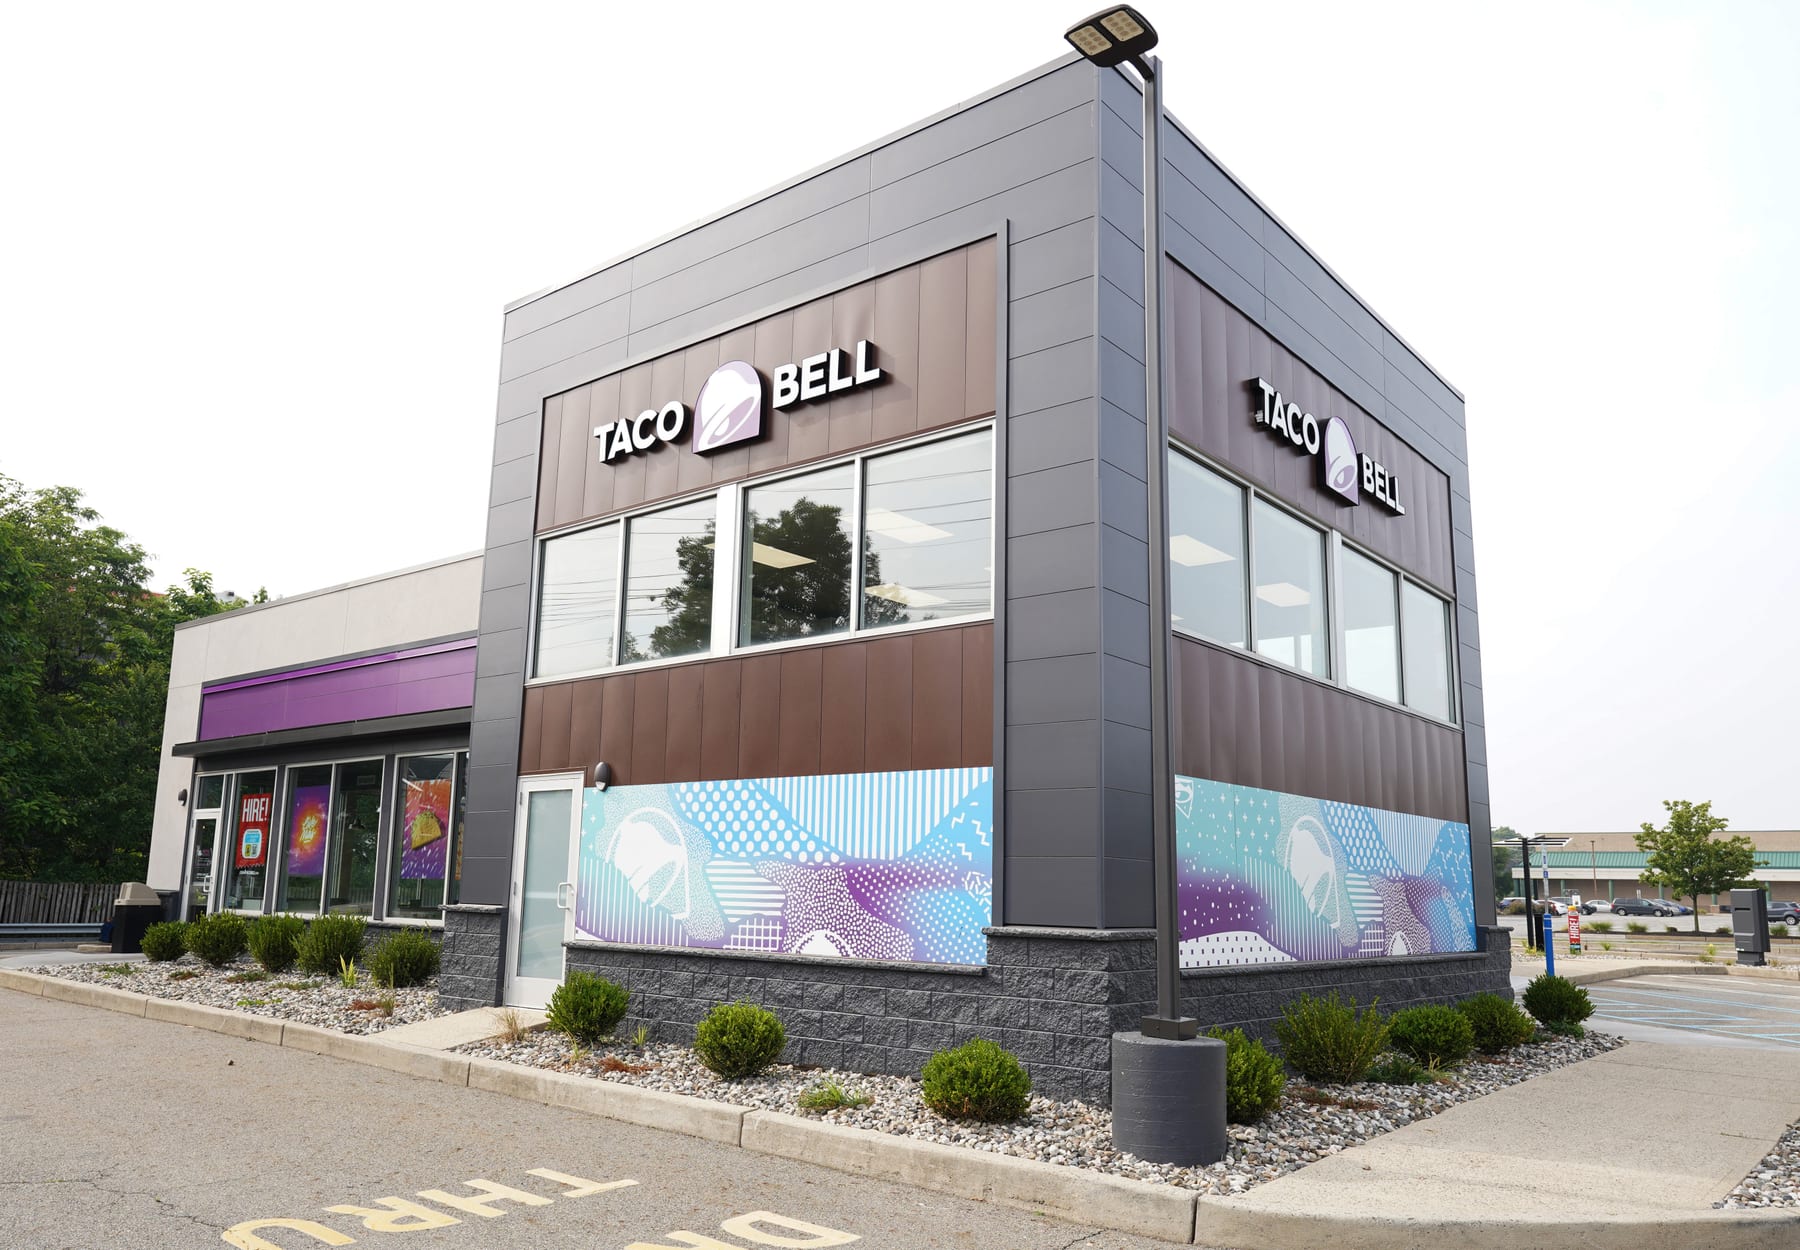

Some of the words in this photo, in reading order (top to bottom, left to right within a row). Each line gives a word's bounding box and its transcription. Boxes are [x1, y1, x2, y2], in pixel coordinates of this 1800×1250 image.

[593, 400, 686, 464] TACO
[772, 339, 882, 410] BELL
[1257, 376, 1321, 456] TACO
[1361, 452, 1406, 515] BELL
[241, 797, 270, 823] HIRE!
[220, 1167, 641, 1250] THRU
